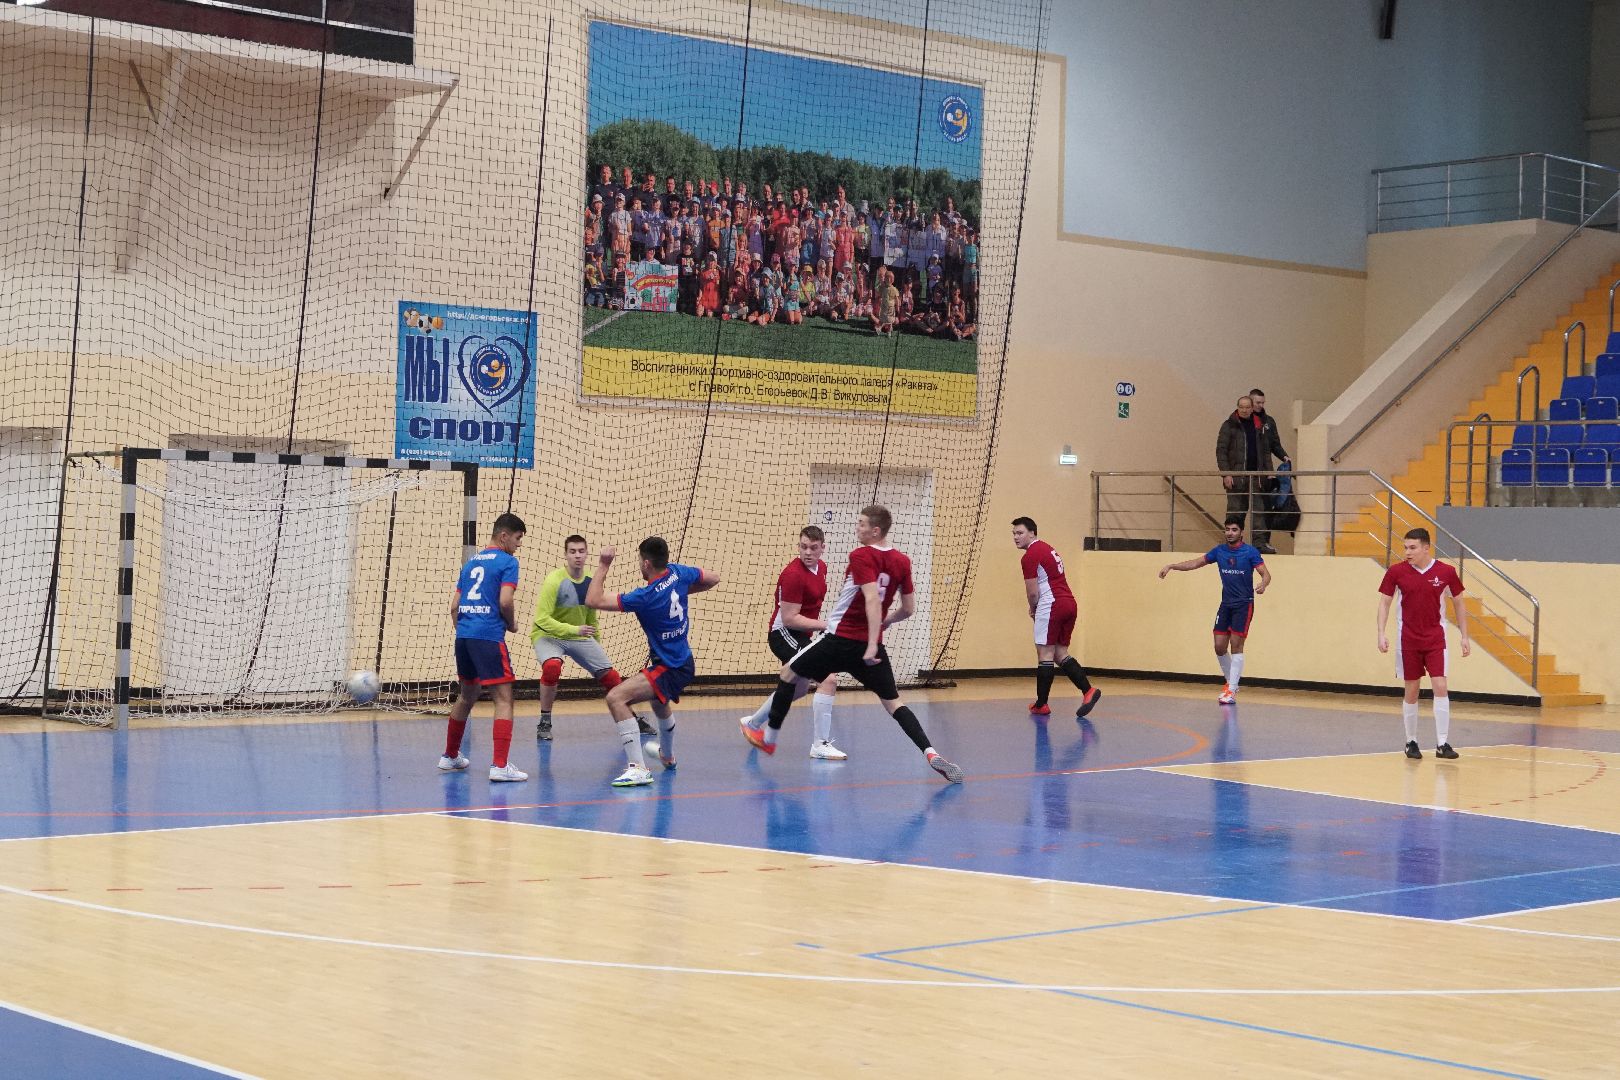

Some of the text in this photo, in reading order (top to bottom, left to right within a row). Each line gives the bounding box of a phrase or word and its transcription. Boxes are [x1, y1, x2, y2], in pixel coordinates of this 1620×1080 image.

[404, 335, 450, 403] МЫ
[631, 360, 707, 375] Воспитанники
[861, 378, 892, 390] лагеря
[896, 378, 938, 391] «Ракета»
[757, 384, 808, 399] Егорьевск
[467, 566, 485, 600] 2
[458, 605, 491, 614] ГОРЬЕВСК
[669, 588, 684, 621] 4
